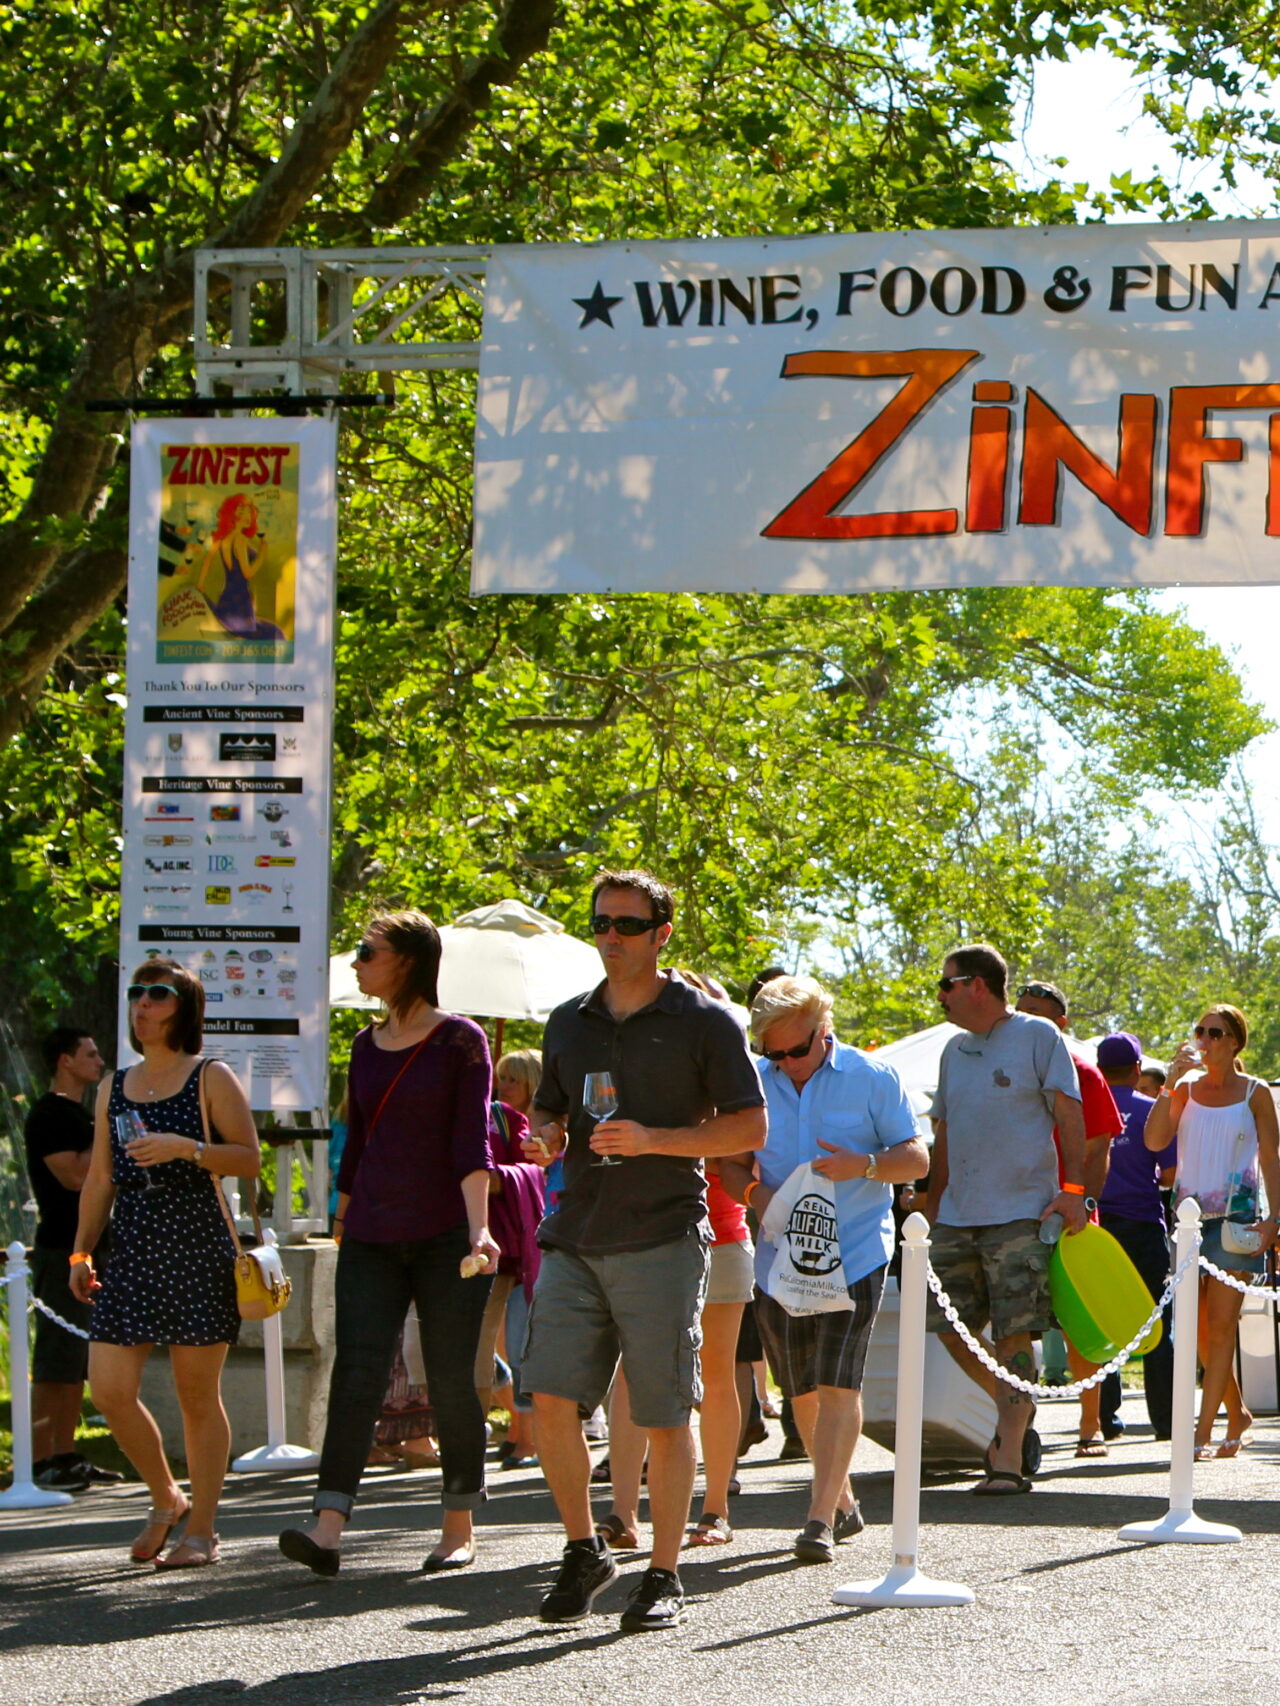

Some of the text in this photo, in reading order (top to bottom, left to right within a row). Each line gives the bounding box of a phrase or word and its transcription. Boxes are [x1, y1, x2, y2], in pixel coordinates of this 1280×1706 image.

[633, 274, 819, 332] WINE,
[836, 266, 1027, 318] FOOD
[1042, 265, 1092, 314] &
[1109, 263, 1240, 312] FUN
[167, 446, 290, 485] ZINFEST
[144, 681, 305, 695] Thank You To Our Sponsors
[163, 709, 284, 721] Ancient Vine Sponsors
[158, 780, 286, 792] Heritage Vine Sponsors
[161, 928, 276, 940] Young Vine Sponsors
[234, 1021, 254, 1031] Fan
[803, 1200, 830, 1216] REAL
[795, 1235, 832, 1254] MILK
